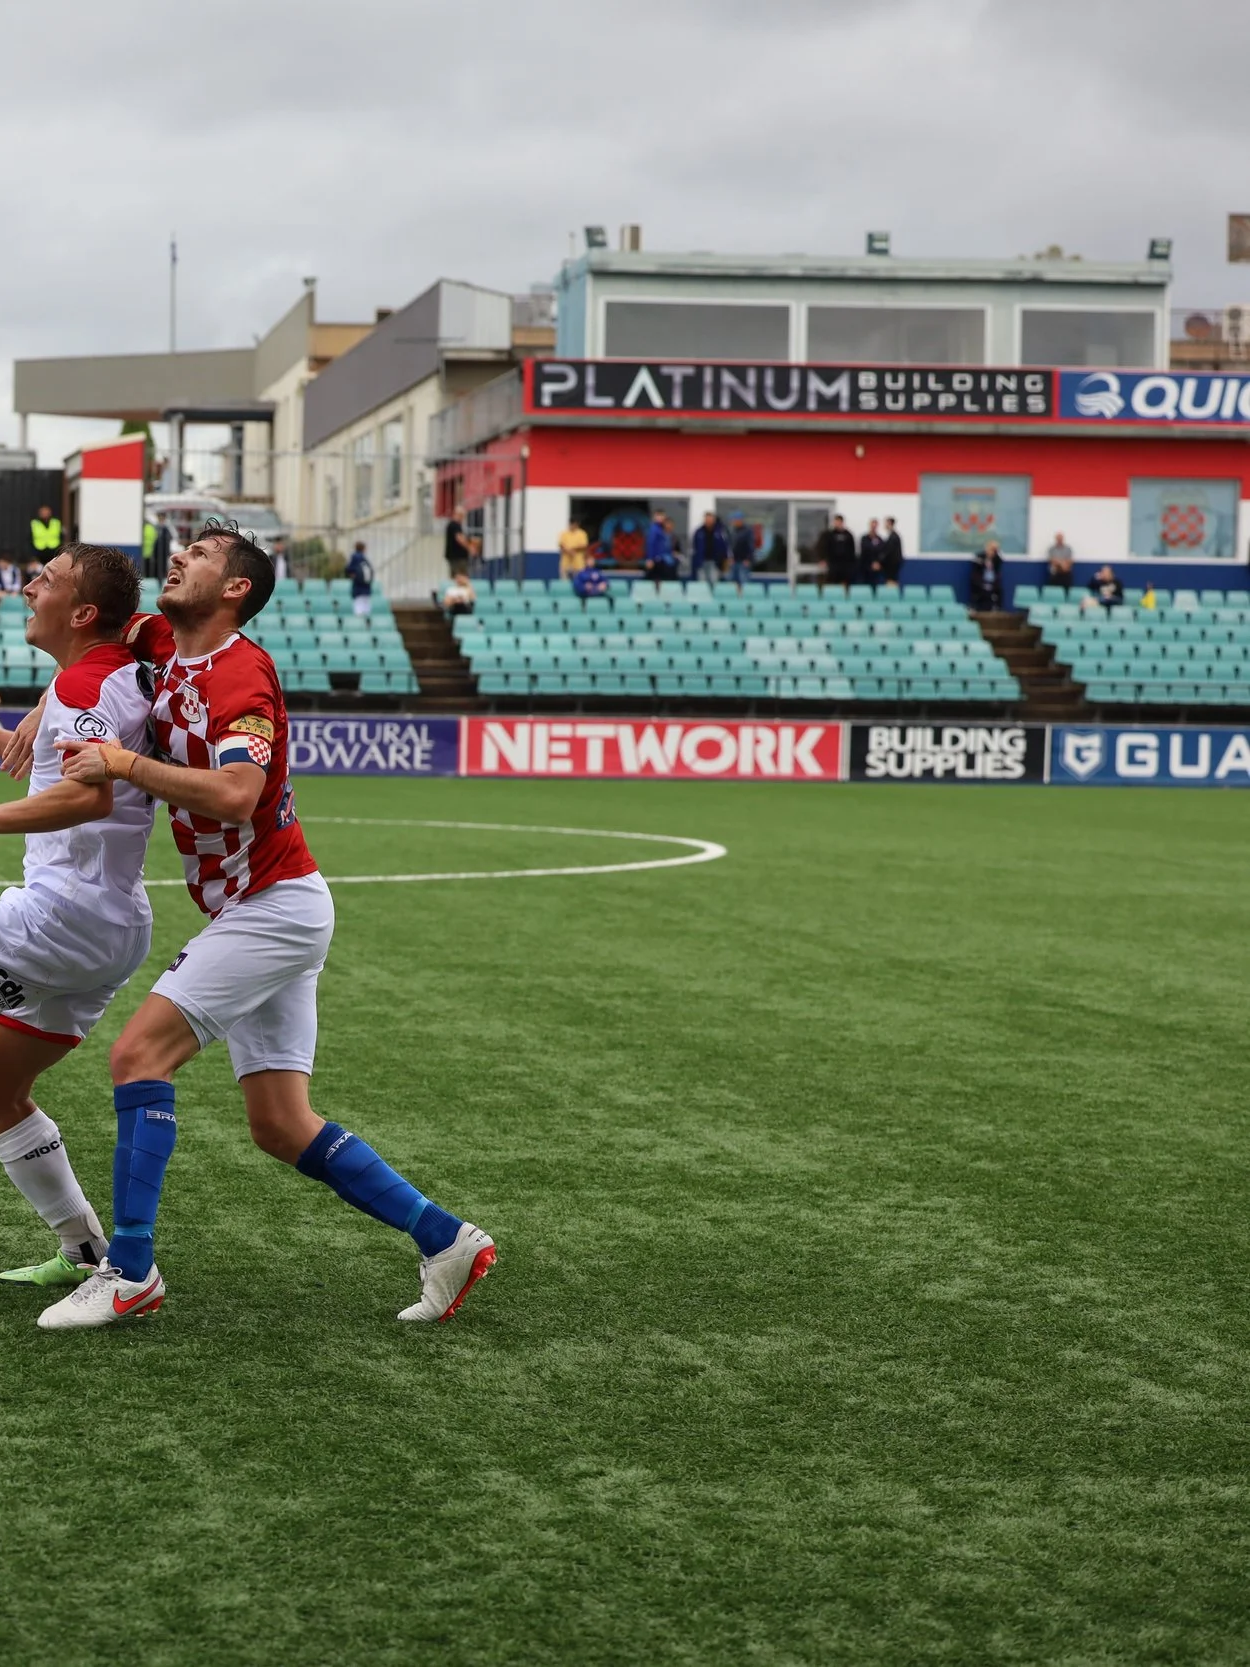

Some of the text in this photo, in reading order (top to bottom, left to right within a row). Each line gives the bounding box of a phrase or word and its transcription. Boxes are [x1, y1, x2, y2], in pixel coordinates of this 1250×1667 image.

[540, 364, 851, 412] PLATINUM
[857, 371, 1045, 393] BUILDING
[858, 392, 1047, 413] SUPPLIES
[288, 740, 433, 771] DWARE
[481, 722, 826, 776] NETWORK
[868, 726, 1027, 755] BUILDING
[1115, 732, 1250, 779] GUA
[865, 750, 1026, 779] SUPPLIES
